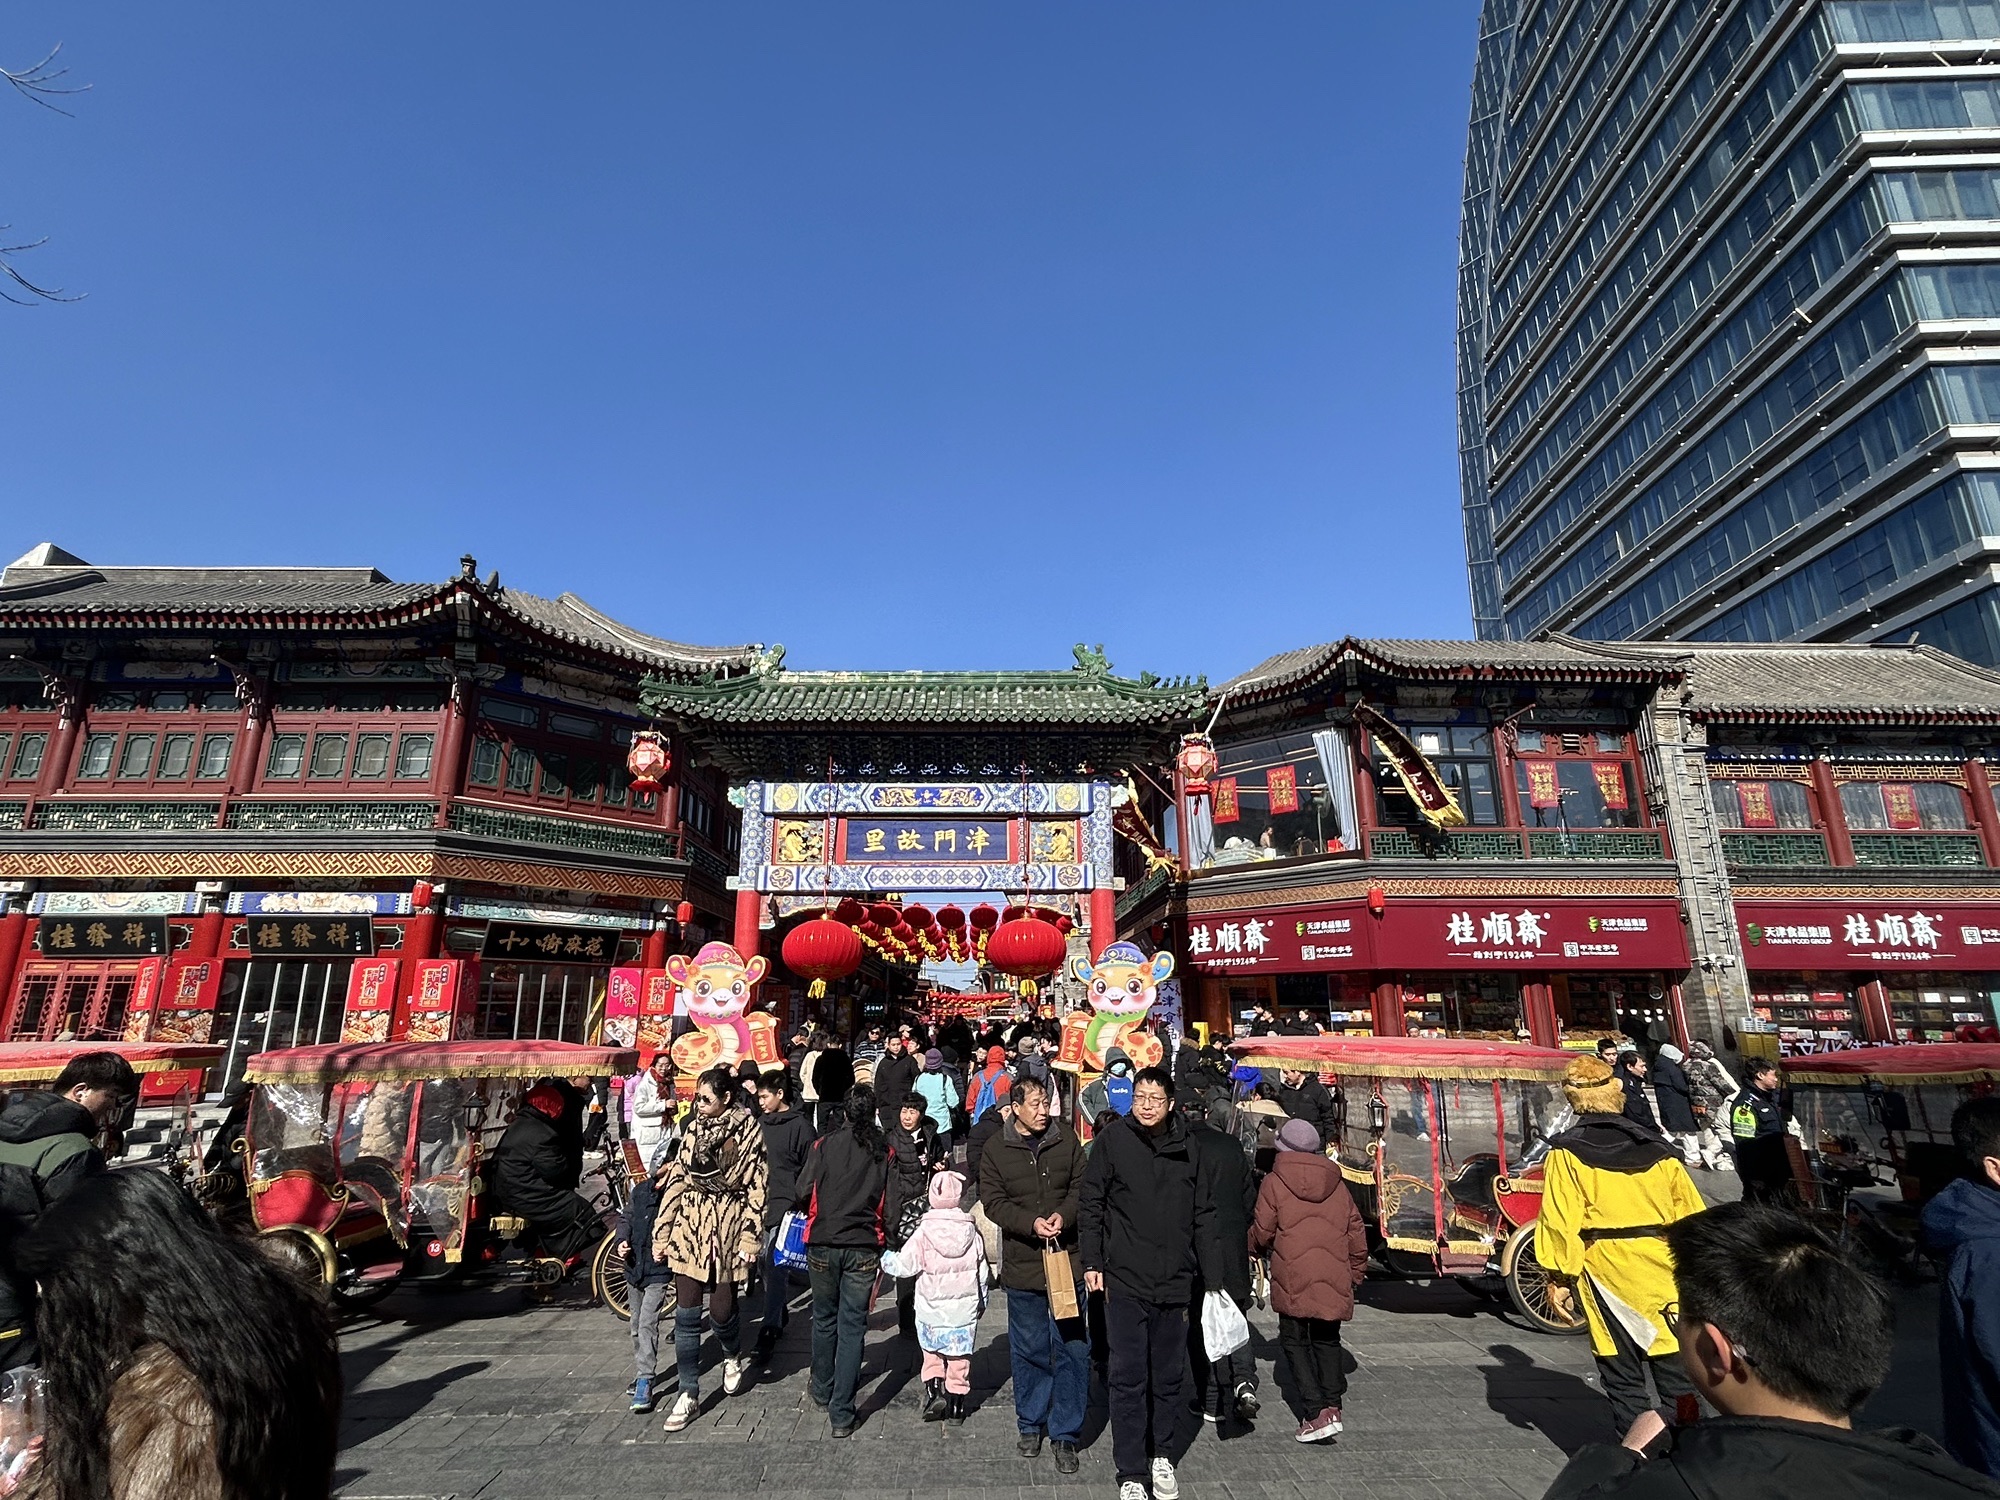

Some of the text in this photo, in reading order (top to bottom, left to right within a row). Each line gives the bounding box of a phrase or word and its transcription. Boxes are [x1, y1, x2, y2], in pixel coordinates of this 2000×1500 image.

[1764, 926, 1832, 938] 天津食品集团
[499, 930, 604, 956] 十八街麻花
[430, 1243, 441, 1253] 13
